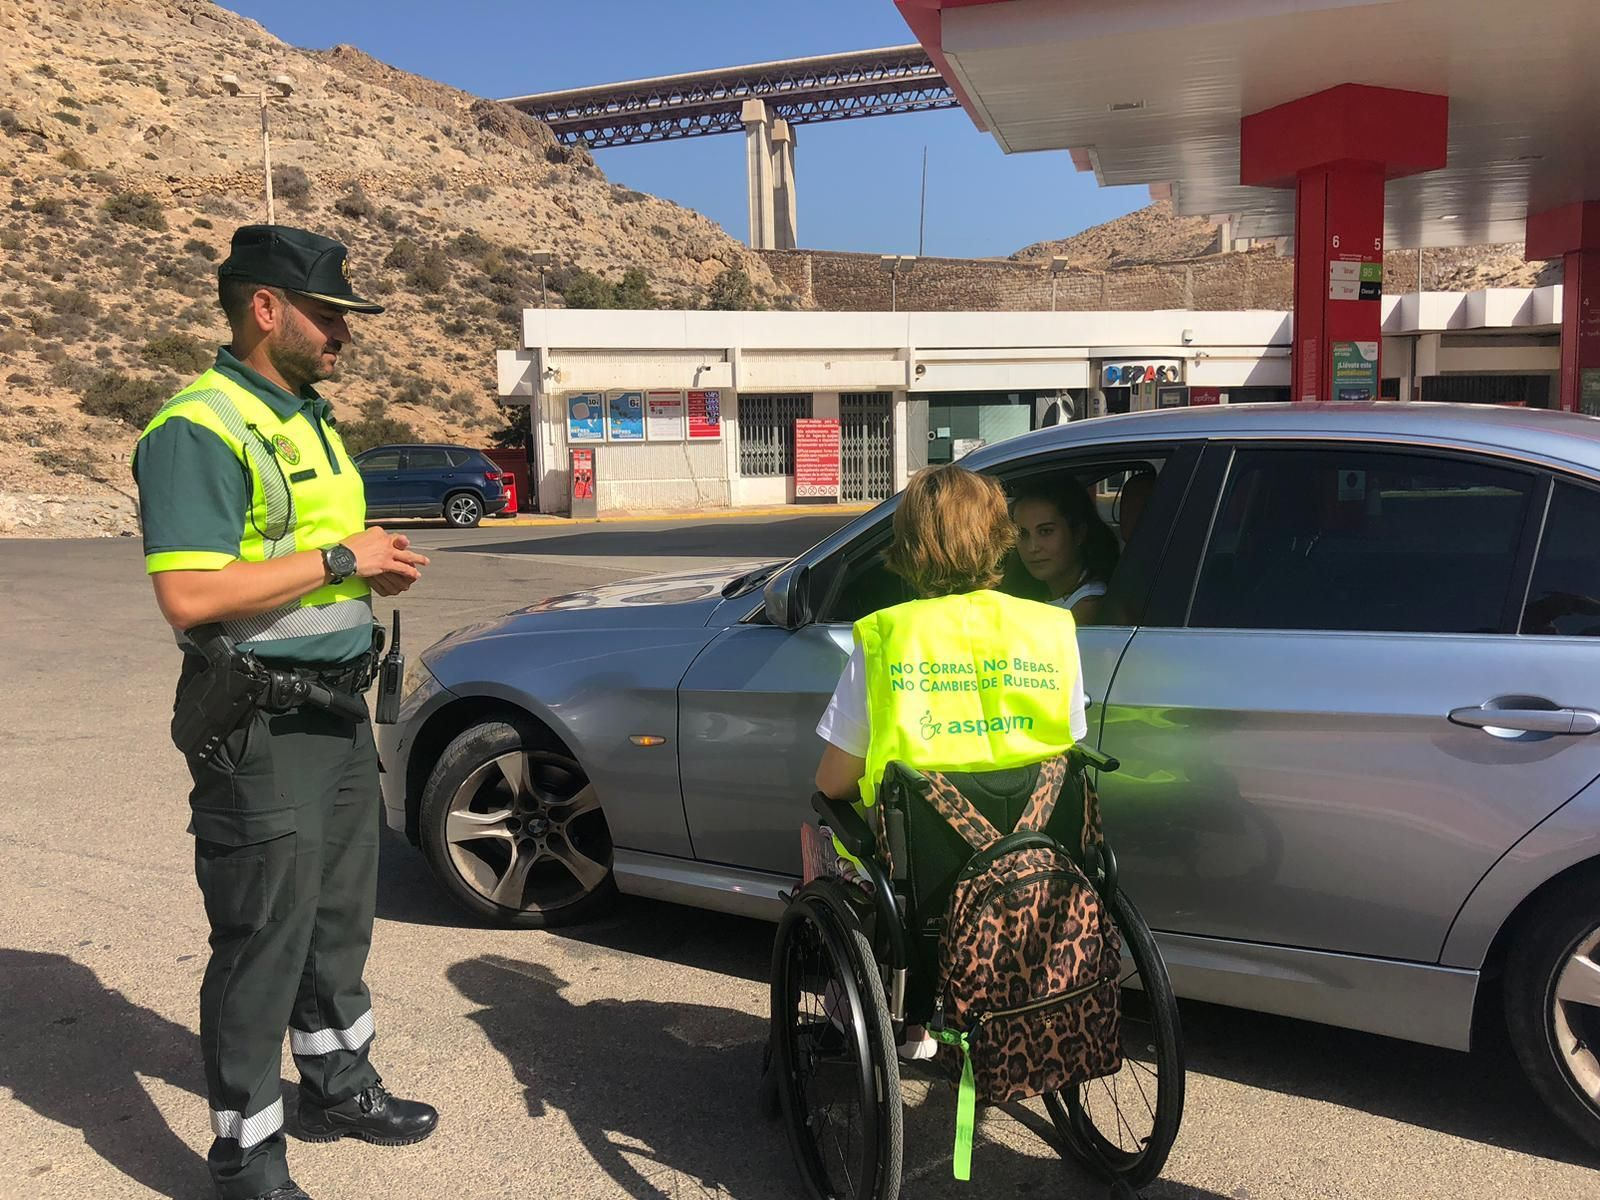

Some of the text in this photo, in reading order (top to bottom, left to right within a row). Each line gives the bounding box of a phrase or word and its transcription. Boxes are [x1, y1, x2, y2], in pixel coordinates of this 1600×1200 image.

[1332, 235, 1340, 248] 6
[1374, 238, 1381, 250] 5
[981, 677, 998, 690] DE
[947, 714, 1033, 736] aspaym
